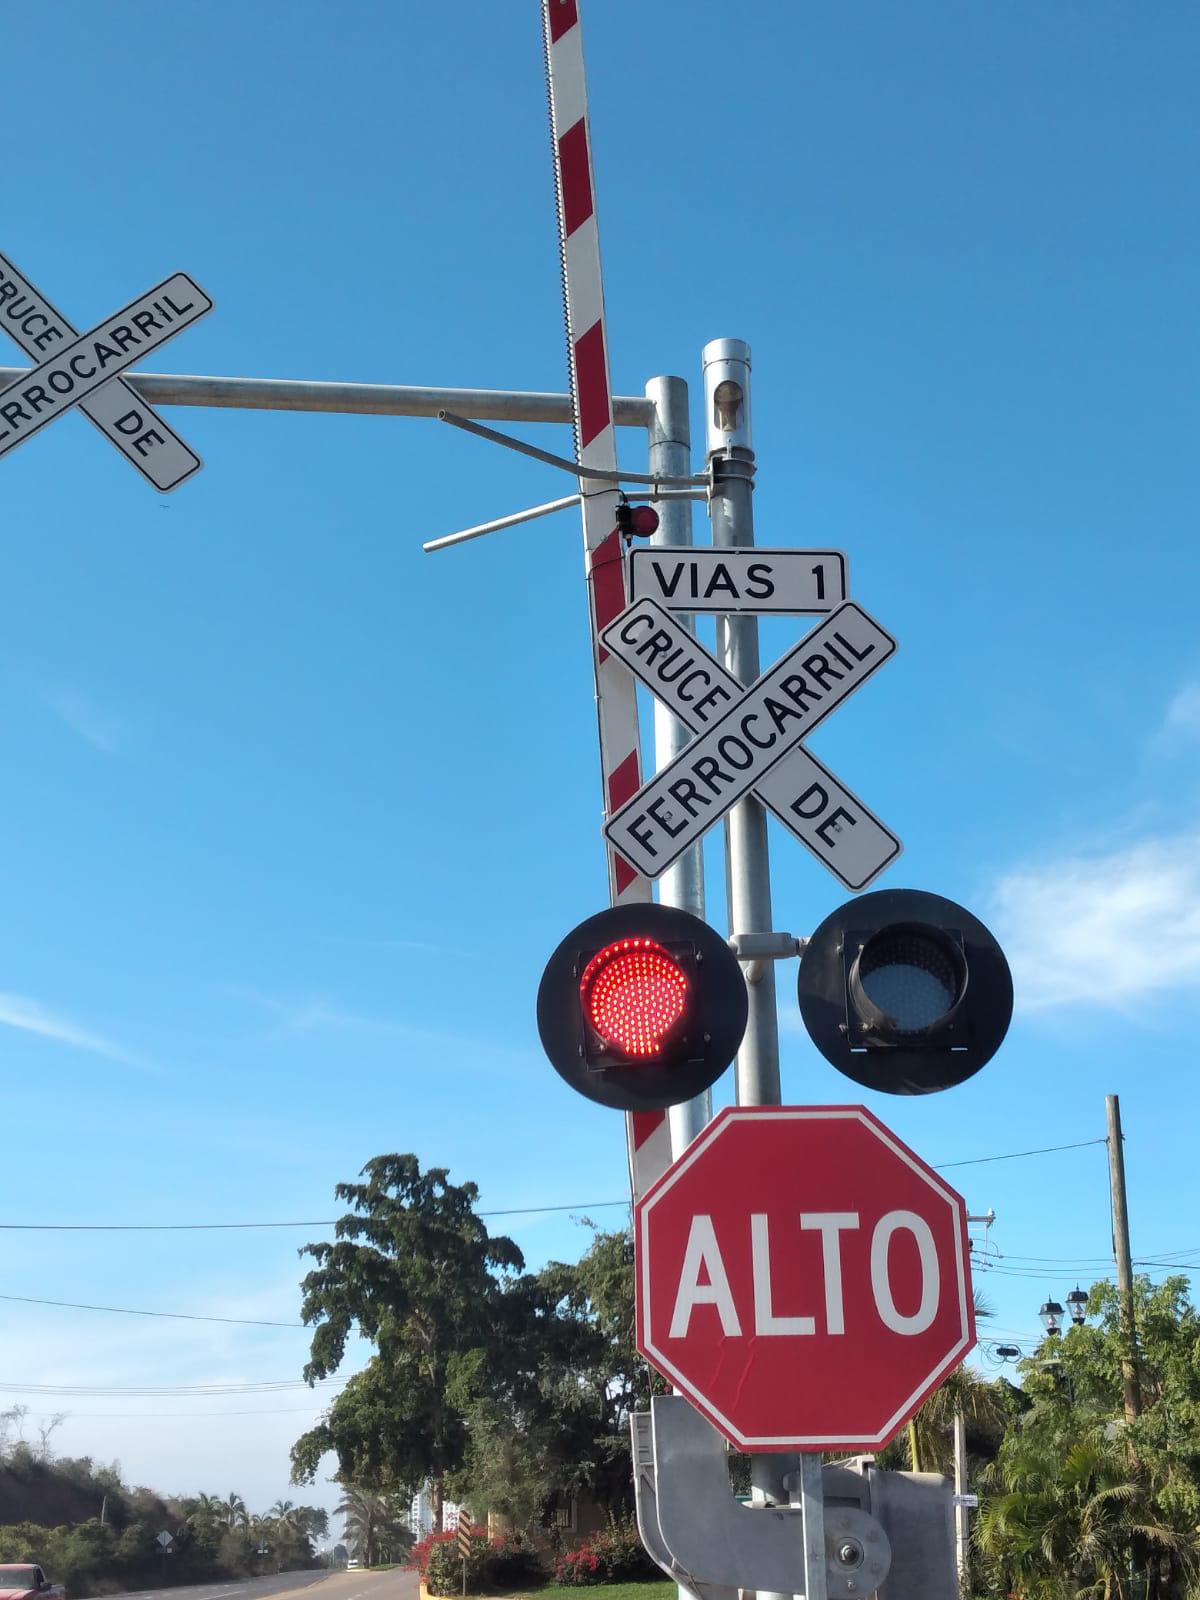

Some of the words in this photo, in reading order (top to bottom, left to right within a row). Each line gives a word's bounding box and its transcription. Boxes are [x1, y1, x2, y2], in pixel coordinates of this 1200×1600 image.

[0, 270, 64, 352] RUCE
[0, 295, 194, 441] RROCARRIL
[112, 409, 165, 457] DE
[651, 562, 775, 600] VIAS
[811, 564, 825, 601] 1
[620, 613, 732, 722] CRUCE
[626, 631, 876, 857] FERROCARRIL
[790, 781, 857, 848] DE
[668, 1209, 941, 1339] ALTO
